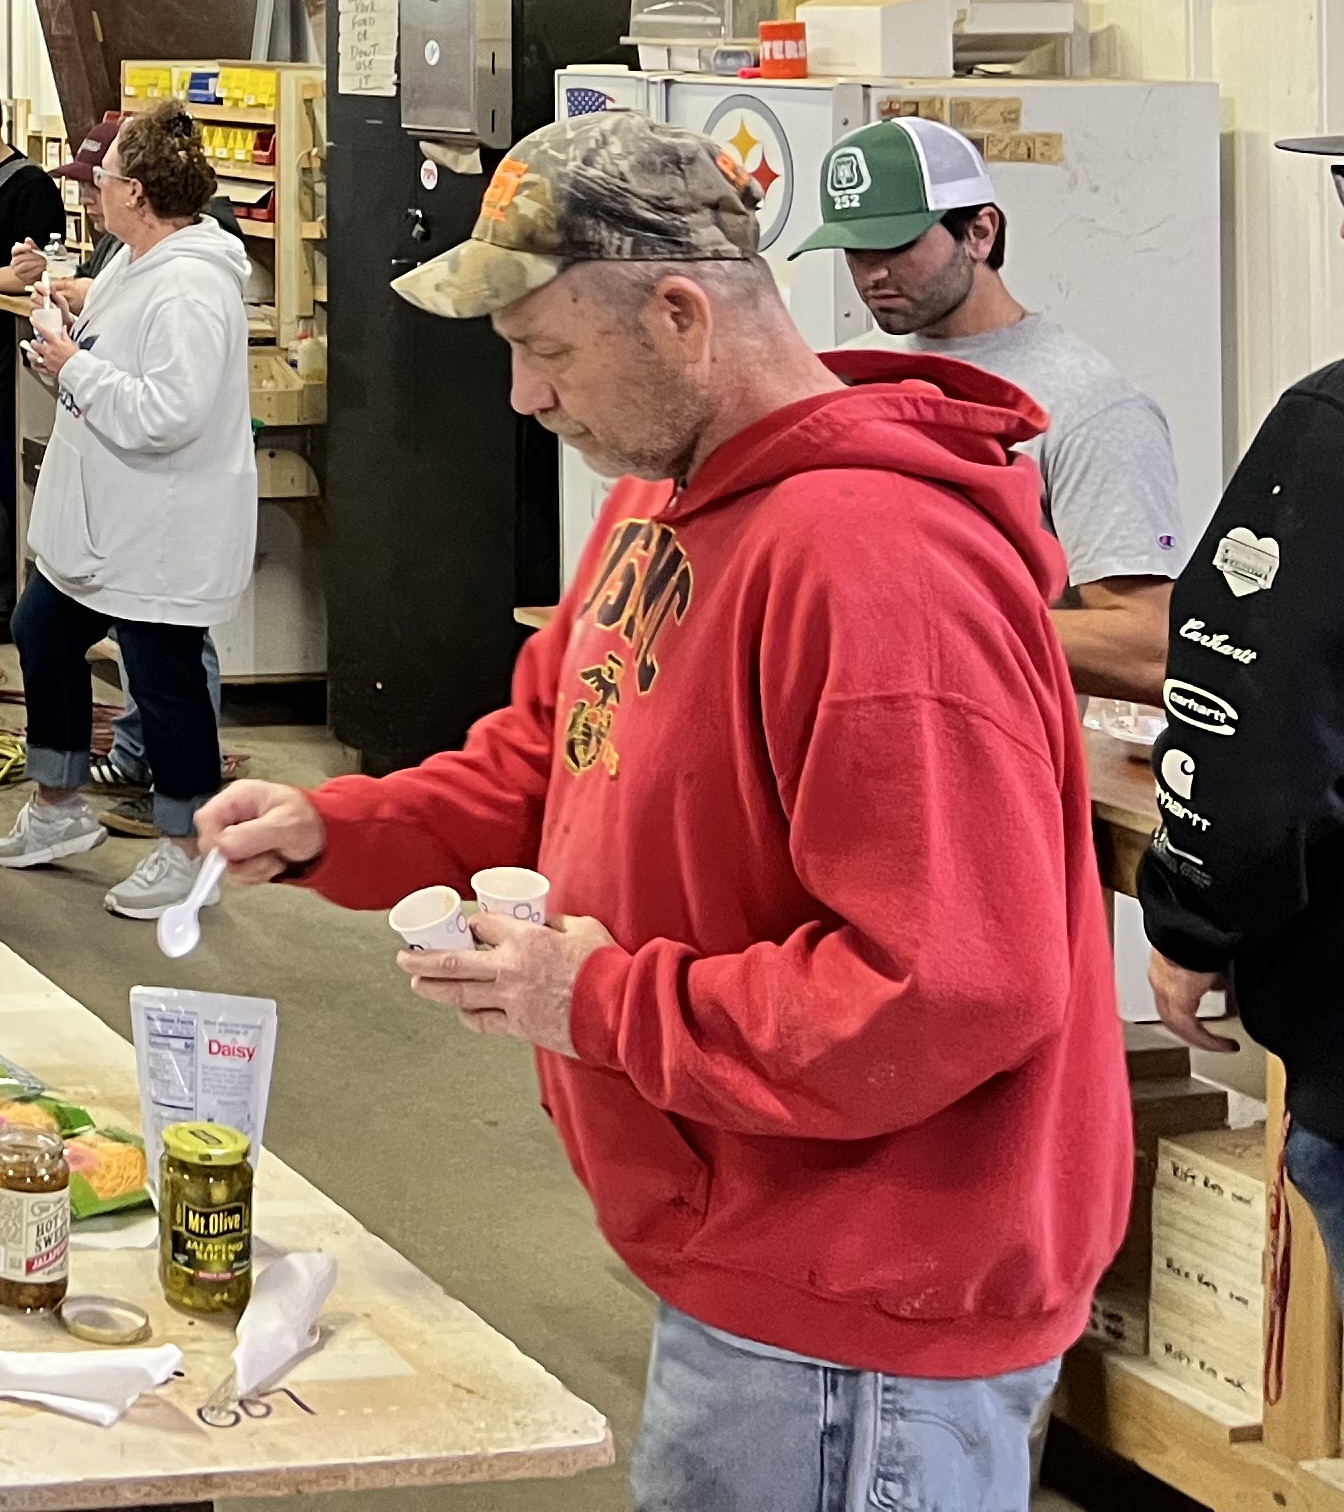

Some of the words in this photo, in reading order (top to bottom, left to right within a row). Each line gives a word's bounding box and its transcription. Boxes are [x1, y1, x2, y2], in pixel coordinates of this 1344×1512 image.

[355, 2, 375, 13] YOUR
[352, 16, 375, 30] FOOD
[357, 29, 369, 42] OR
[356, 58, 374, 71] USE
[359, 74, 372, 88] IT
[834, 194, 860, 210] 252
[1179, 618, 1257, 664] Carhartt
[1169, 691, 1227, 723] carhartt
[208, 1038, 256, 1063] Daisy
[36, 1214, 58, 1237] HOT
[209, 1211, 241, 1235] Olive
